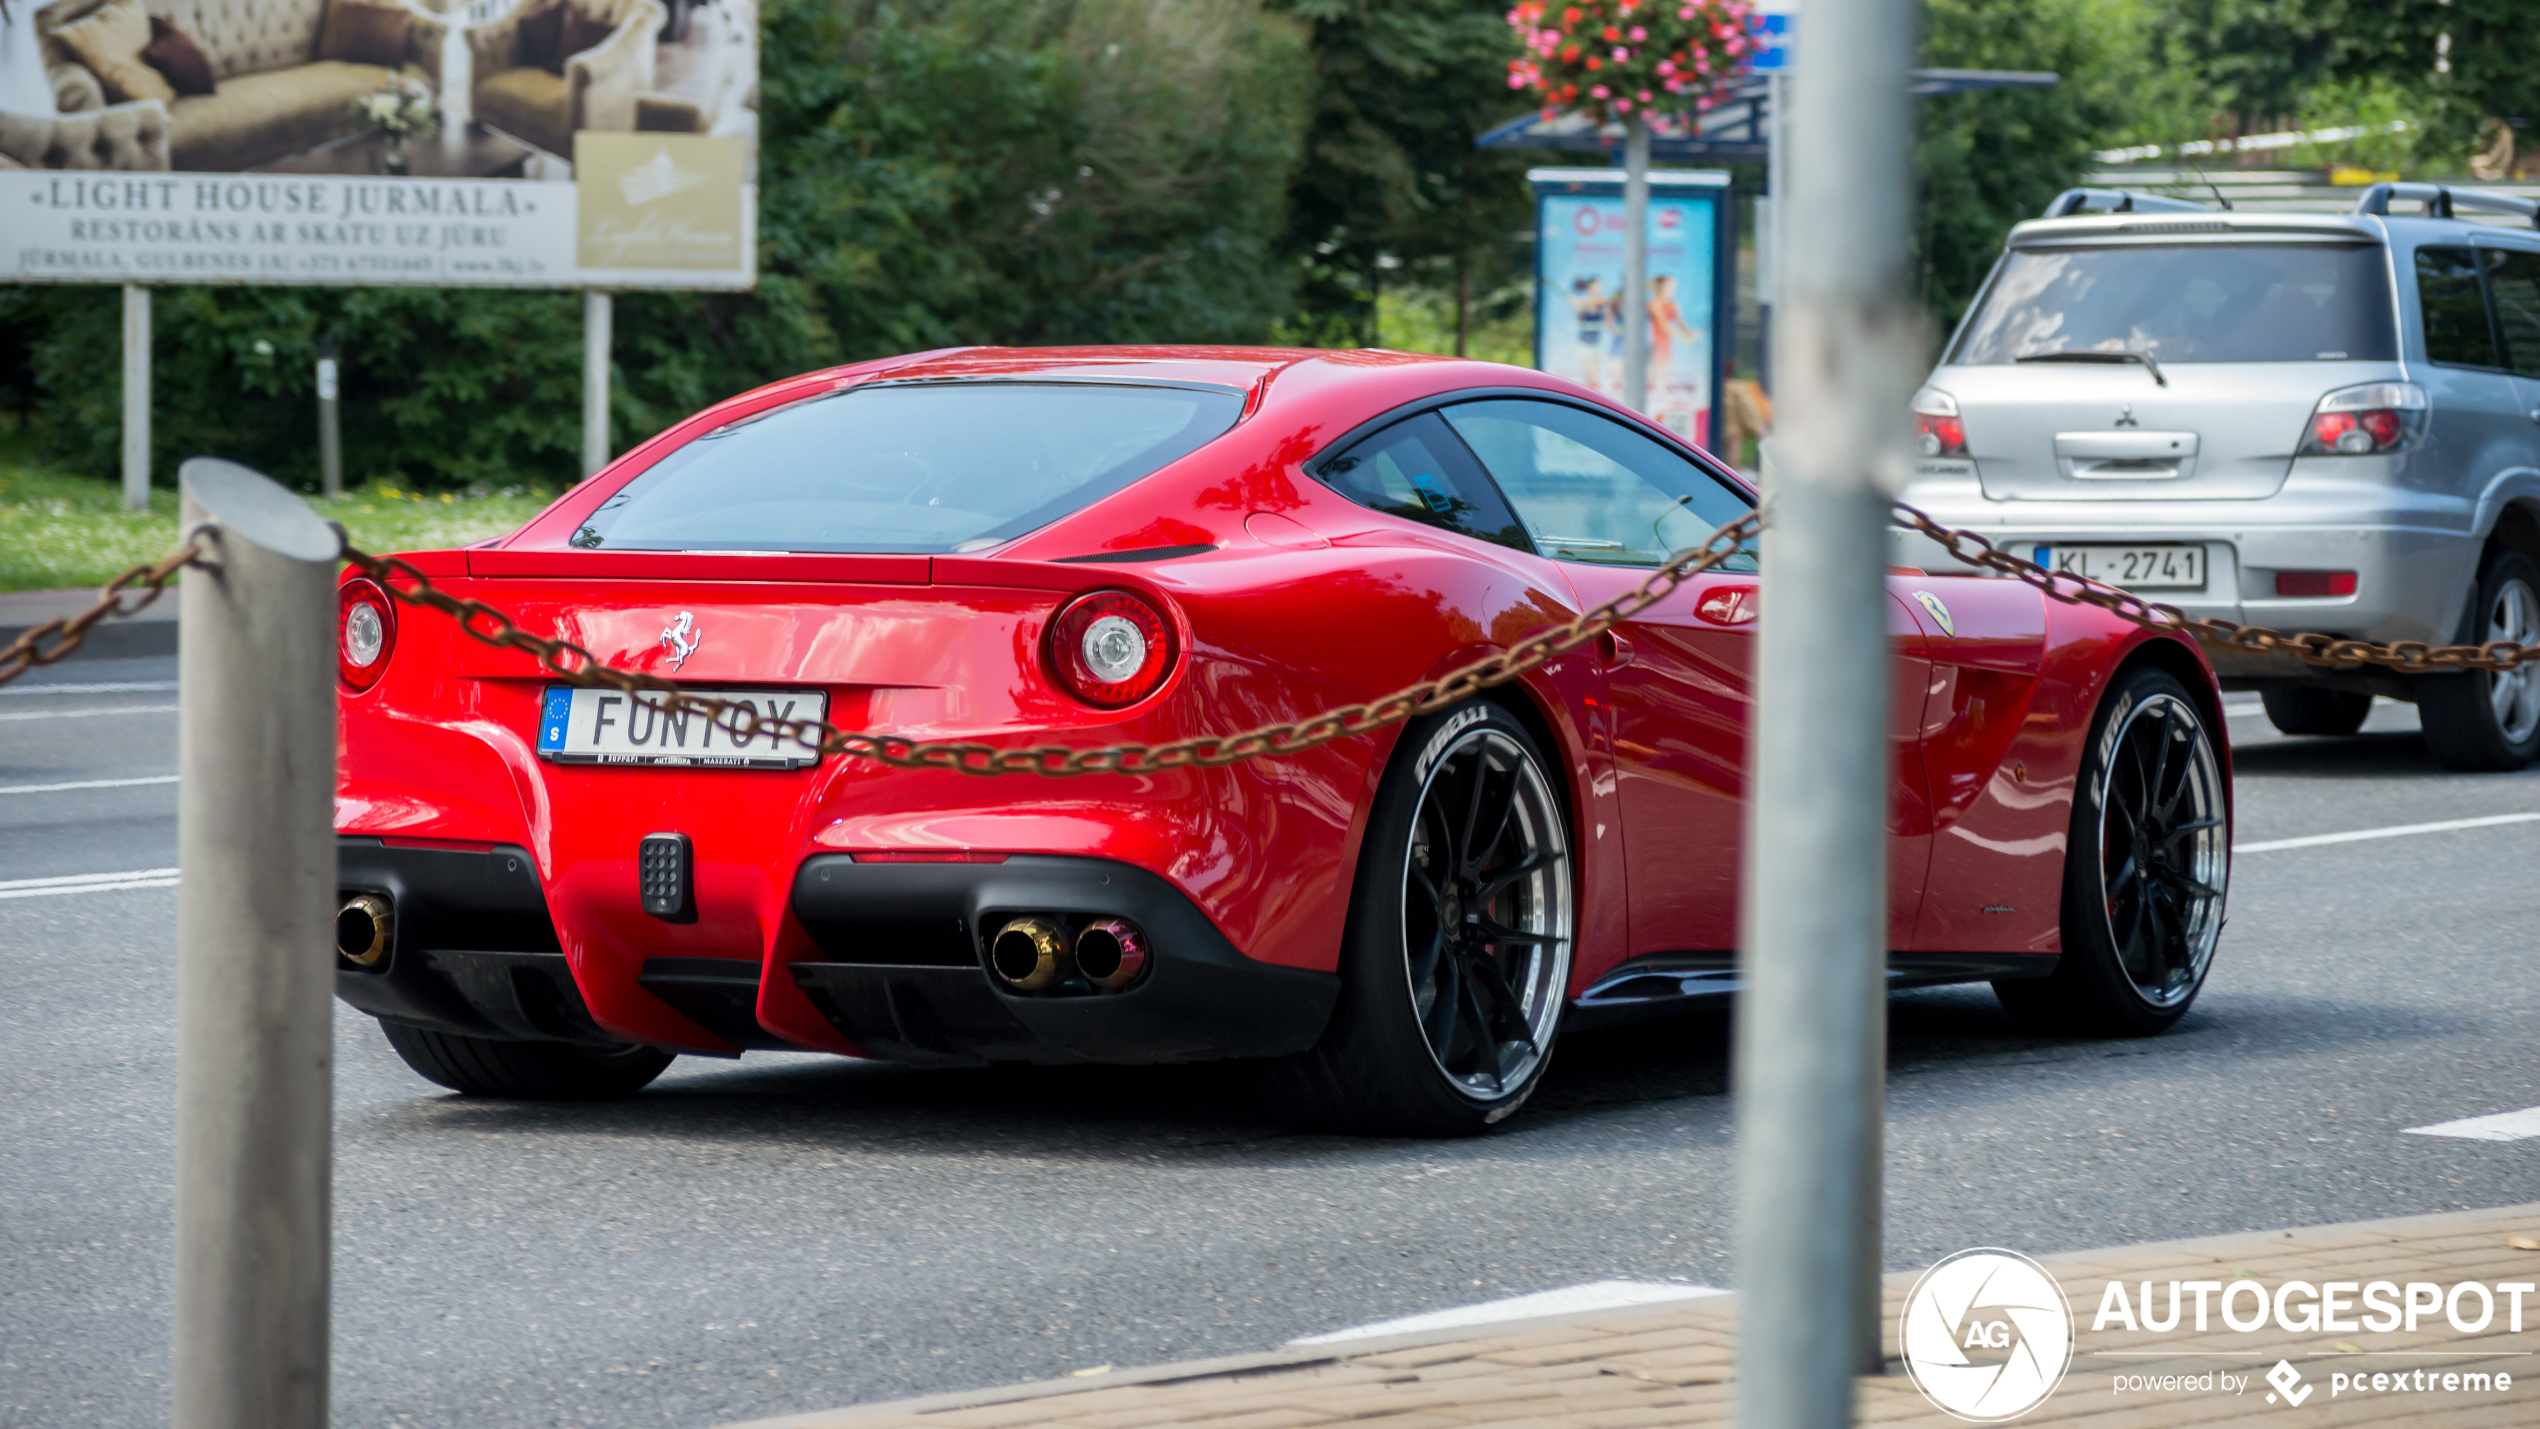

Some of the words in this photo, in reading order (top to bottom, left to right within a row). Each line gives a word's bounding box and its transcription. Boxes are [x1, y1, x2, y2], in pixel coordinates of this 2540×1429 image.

[194, 180, 327, 213] HOUSE
[71, 217, 241, 242] RESTORĀNS
[252, 222, 288, 244] AR
[297, 222, 382, 245] SKATU
[395, 224, 431, 246] UZ
[438, 223, 506, 251] JŪRU
[549, 726, 560, 742] S
[592, 696, 797, 750] FUNTOY
[607, 754, 639, 764] Ferrari
[703, 757, 741, 767] MASERATI
[1414, 705, 1489, 788] PIRELLI
